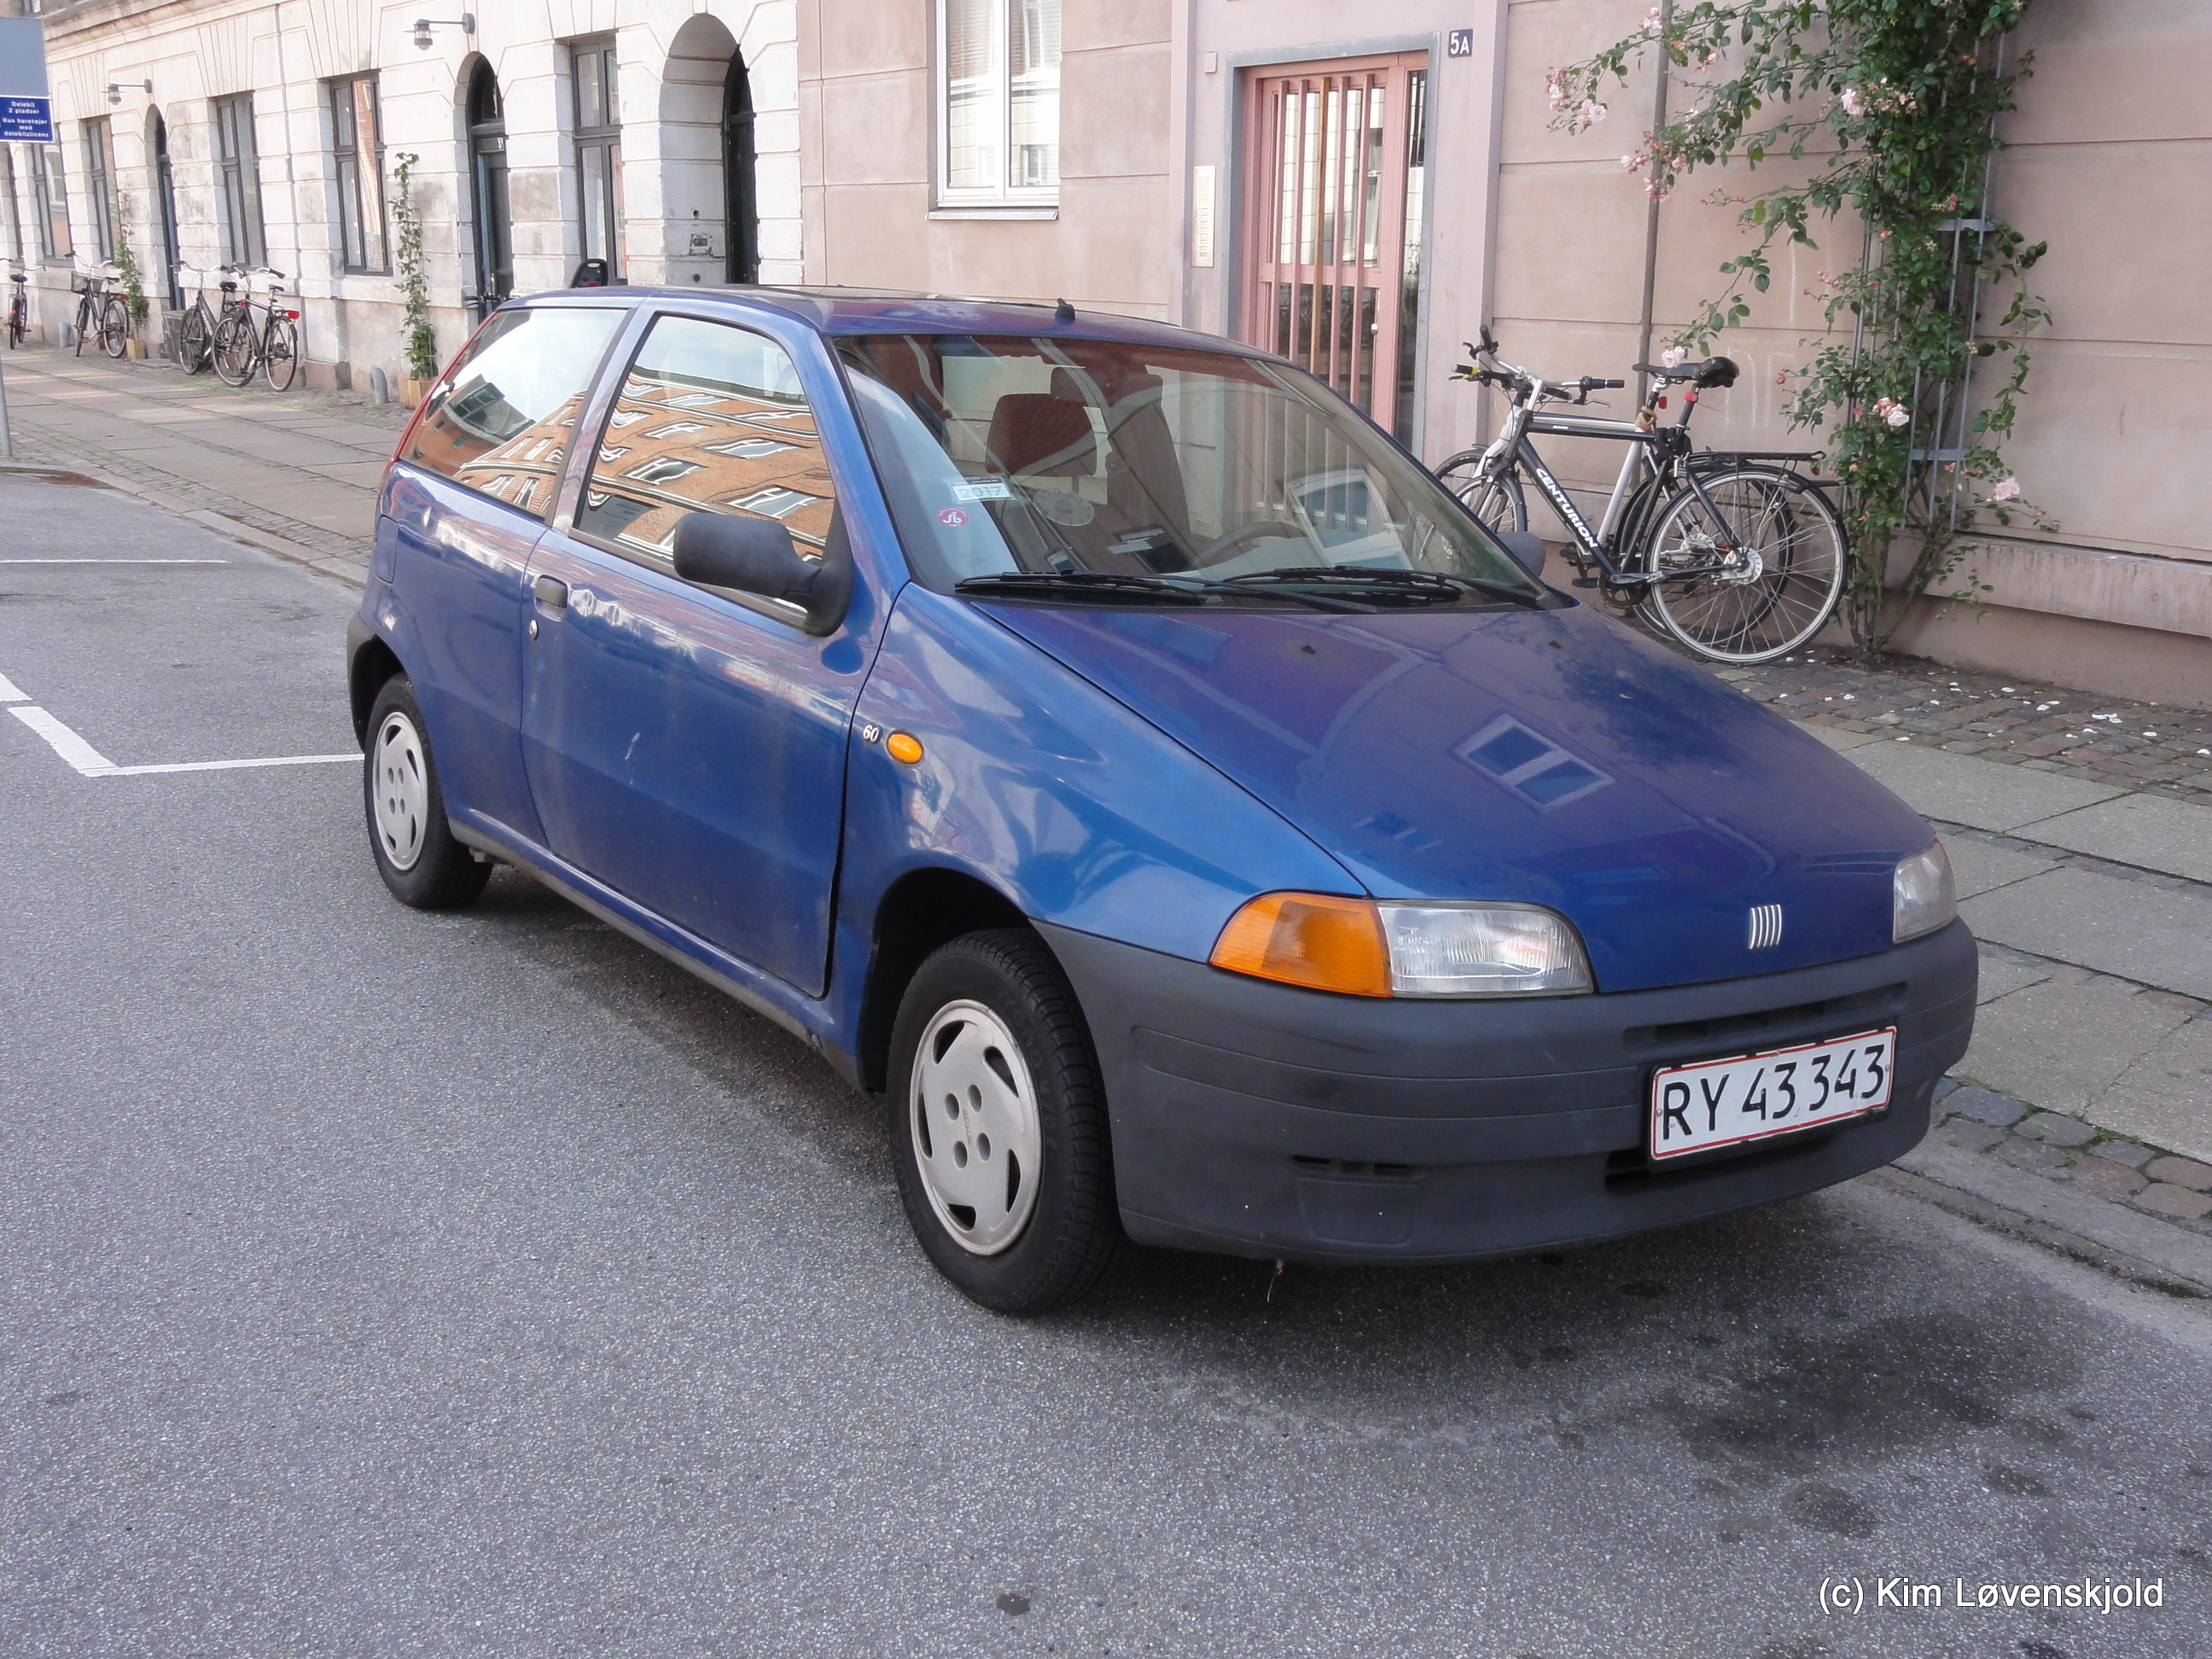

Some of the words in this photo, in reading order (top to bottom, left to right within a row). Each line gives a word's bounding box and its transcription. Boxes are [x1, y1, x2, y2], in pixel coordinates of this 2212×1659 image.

[1450, 32, 1470, 55] 5A
[958, 486, 1002, 498] 2017
[1536, 468, 1598, 548] CENTURION
[863, 725, 880, 742] 60
[1662, 1074, 1730, 1140] RY
